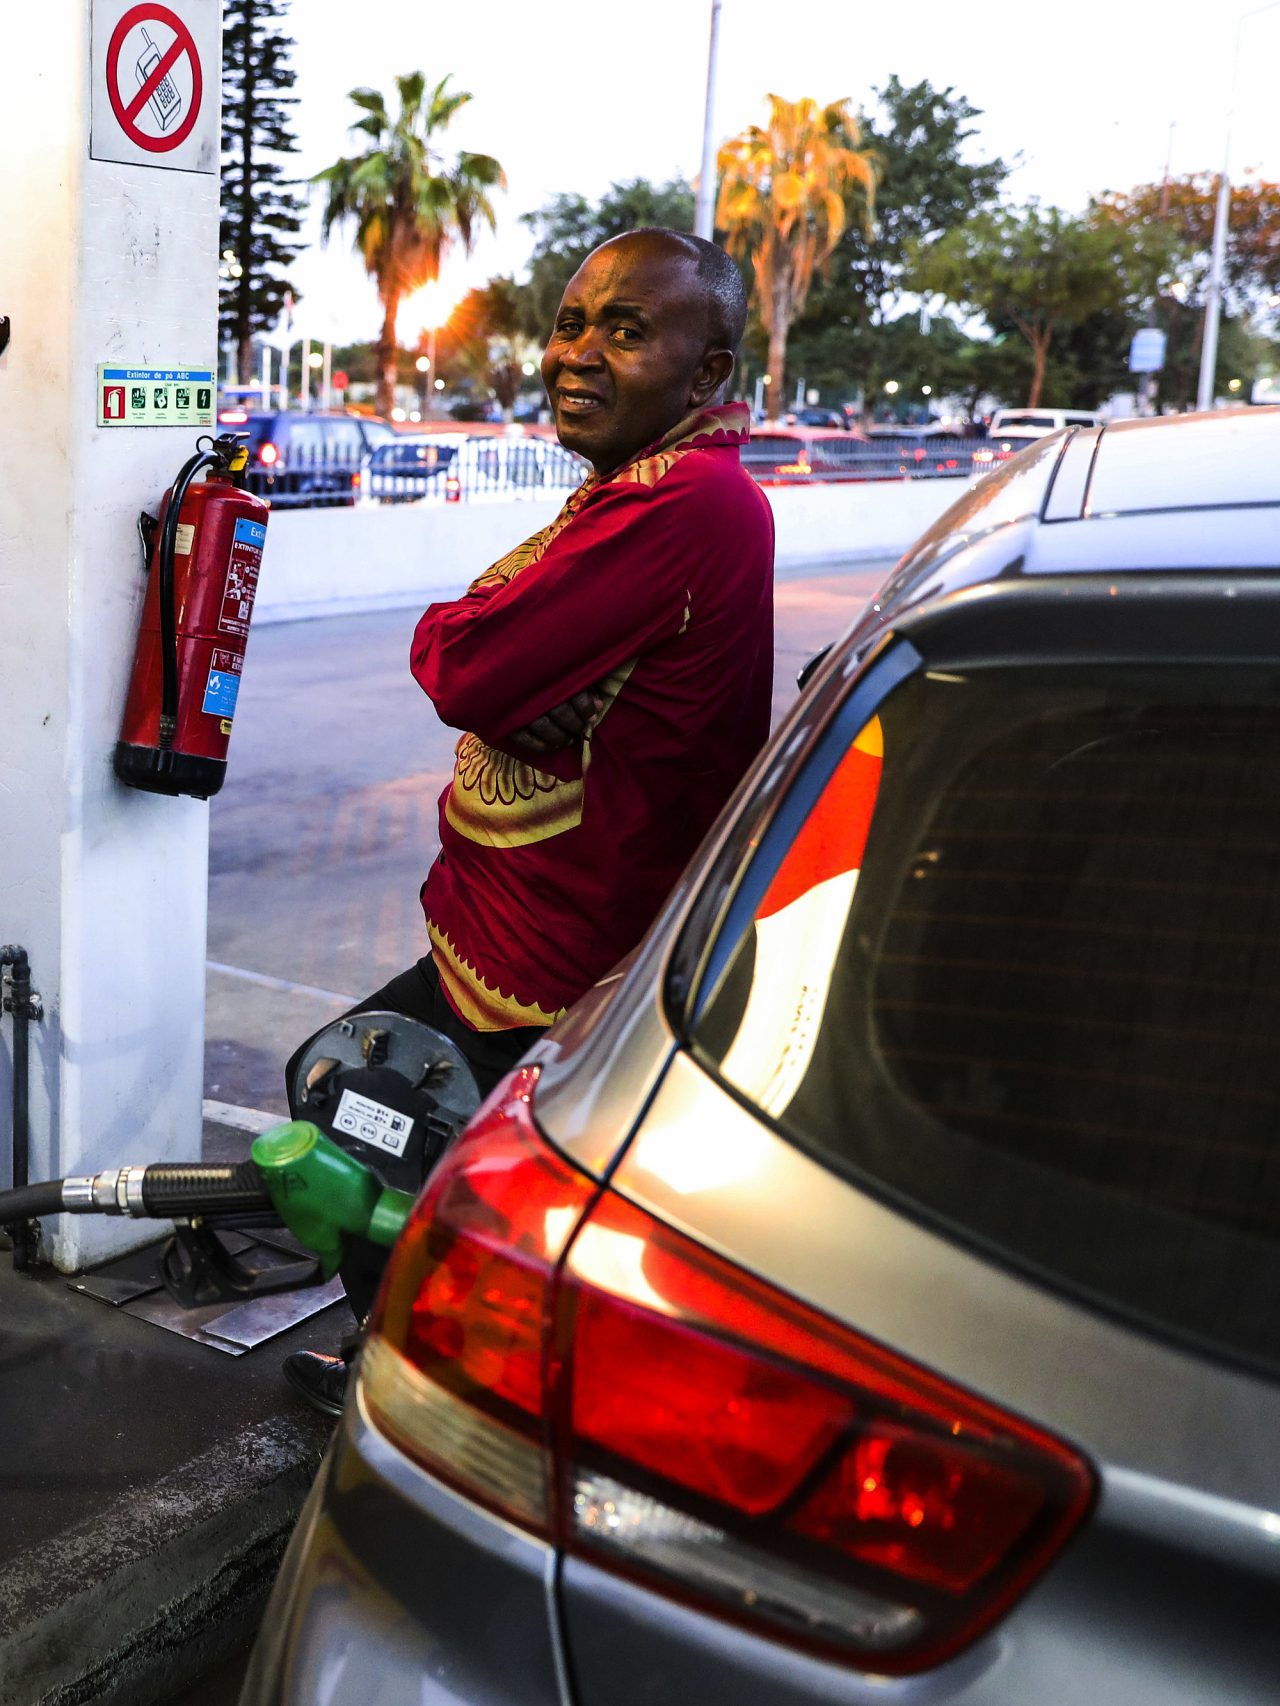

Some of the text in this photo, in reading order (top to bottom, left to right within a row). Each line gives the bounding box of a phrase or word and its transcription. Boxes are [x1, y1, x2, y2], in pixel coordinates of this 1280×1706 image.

[126, 371, 151, 379] Extintor
[165, 371, 173, 380] pó
[176, 372, 190, 380] ABC
